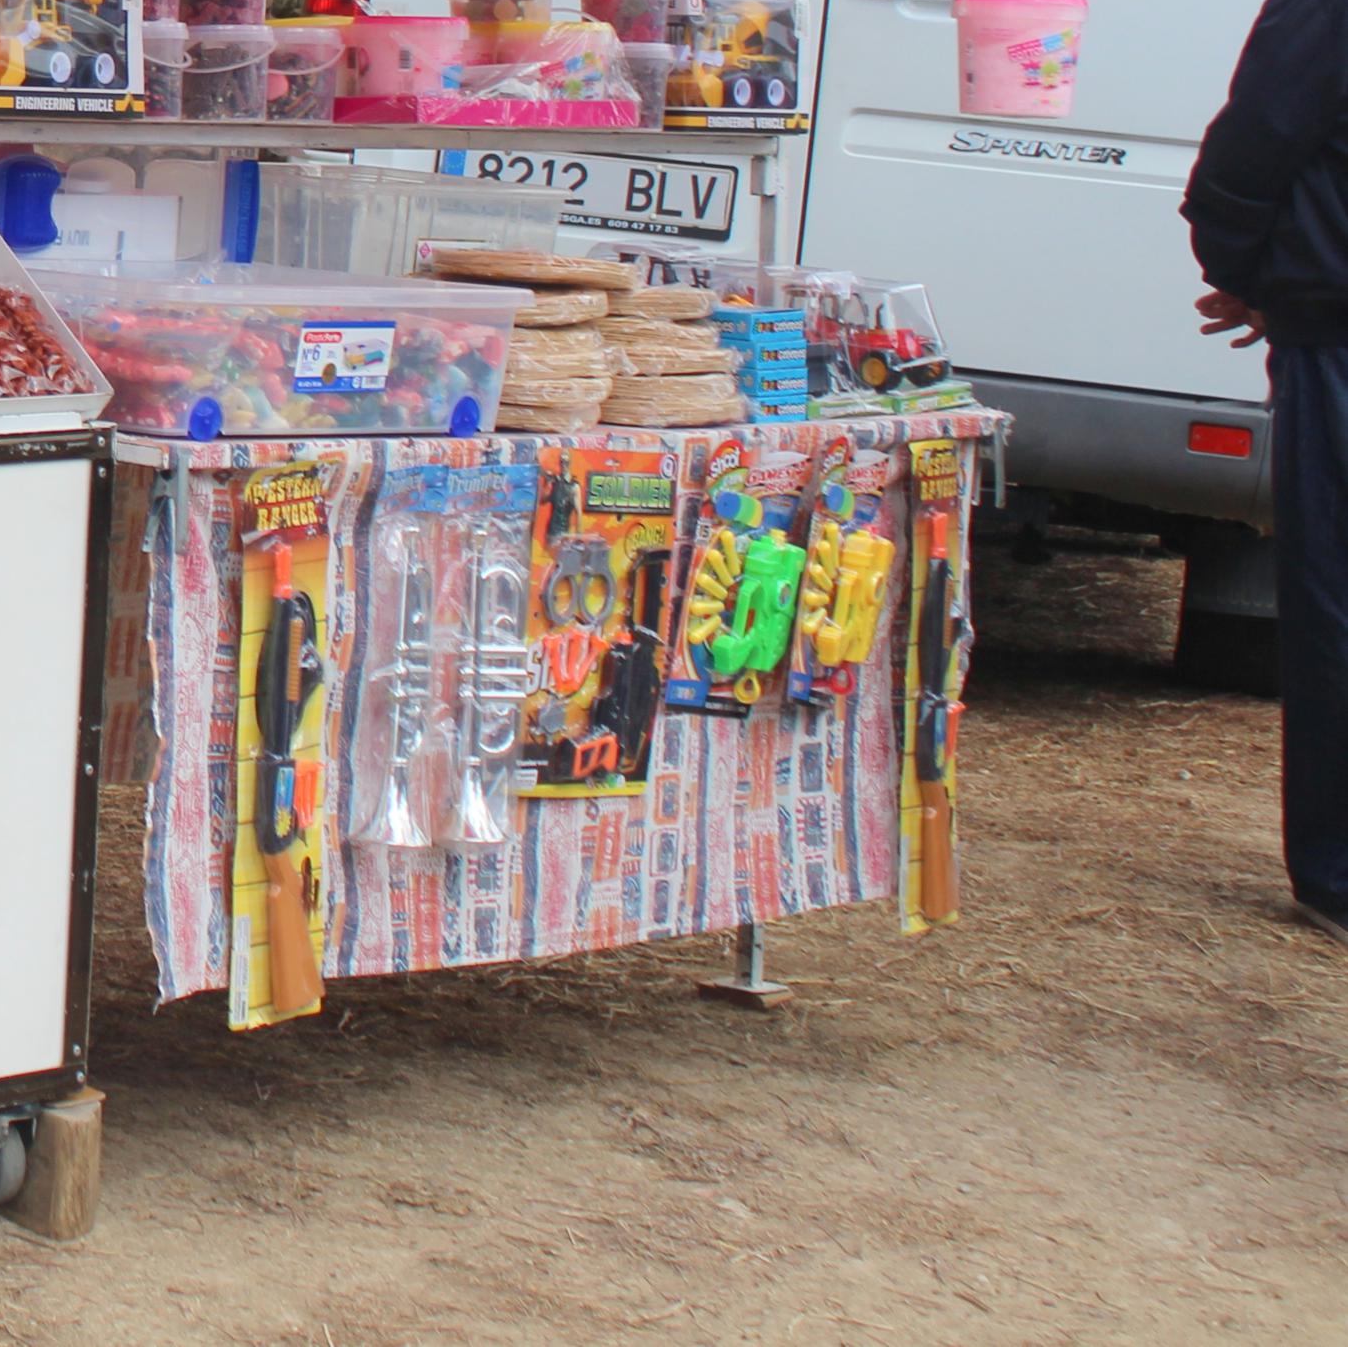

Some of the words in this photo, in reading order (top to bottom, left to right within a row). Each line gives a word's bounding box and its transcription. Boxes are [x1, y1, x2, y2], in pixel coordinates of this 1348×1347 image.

[15, 96, 76, 112] ENGINEERING
[77, 98, 114, 112] VEHICLE
[707, 116, 755, 129] ENGINEERING
[756, 117, 786, 129] VEHICLE
[949, 129, 1126, 165] SPRINTER
[478, 153, 588, 206] 8212
[625, 168, 718, 220] BLV
[608, 218, 629, 229] 609
[631, 221, 645, 231] 47
[649, 224, 663, 234] 17
[246, 478, 321, 505] WESTERN
[587, 475, 672, 509] SOLDIER
[256, 501, 318, 531] RANGER
